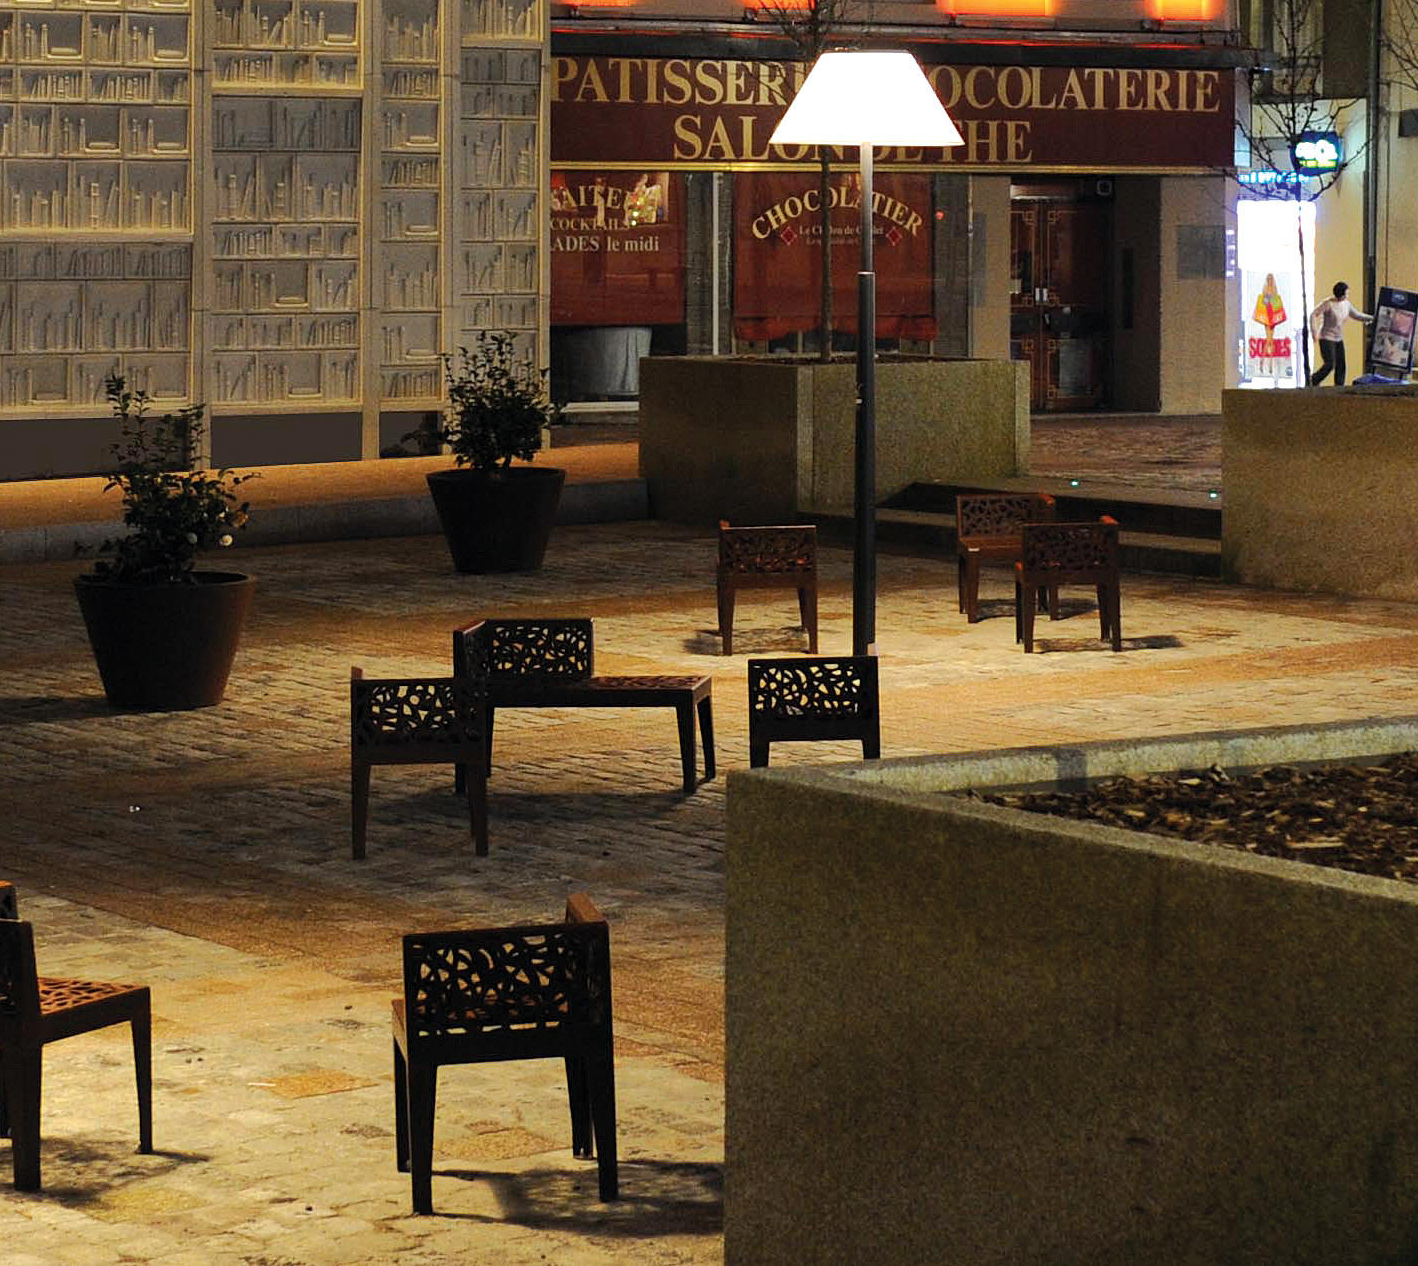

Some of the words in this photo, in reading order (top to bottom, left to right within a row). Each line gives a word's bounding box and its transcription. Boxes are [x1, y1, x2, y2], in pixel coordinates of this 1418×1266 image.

[550, 57, 810, 105] PATISSERI
[927, 65, 1221, 112] OCOLATERIE
[752, 186, 923, 239] CHOCOLTIER
[550, 235, 600, 252] ADES
[607, 236, 620, 252] le
[625, 236, 660, 252] midi
